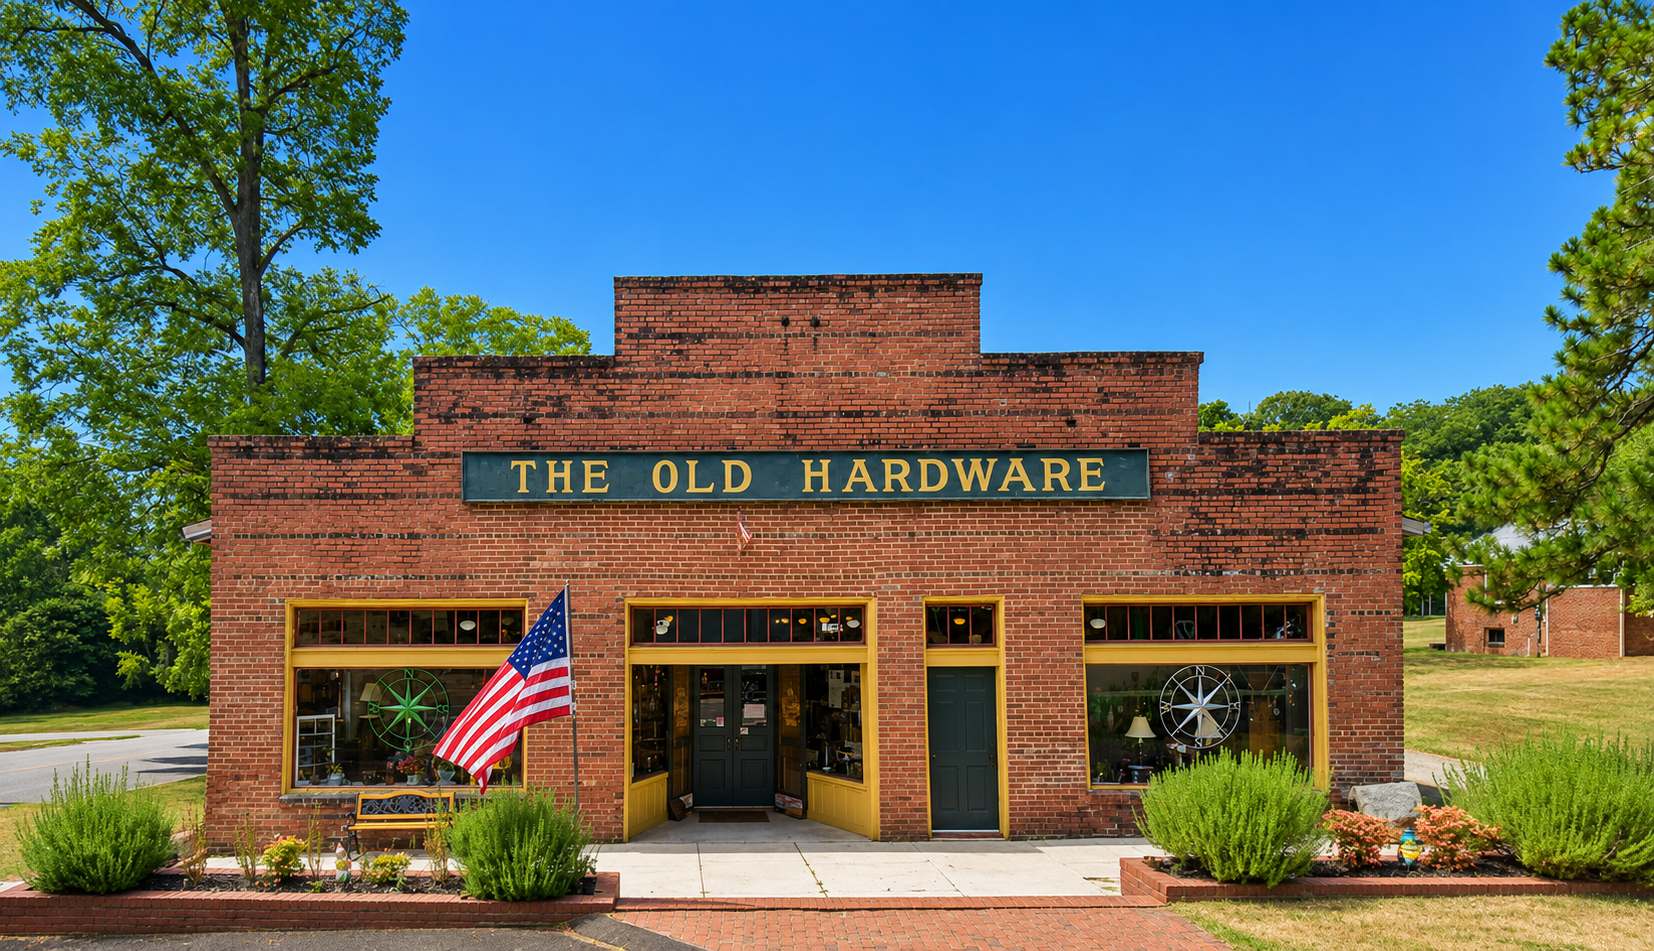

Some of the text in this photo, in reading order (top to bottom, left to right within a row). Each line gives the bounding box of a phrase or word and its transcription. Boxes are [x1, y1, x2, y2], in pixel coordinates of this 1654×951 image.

[510, 458, 1106, 494] THE OLD HARDWARE
[403, 668, 415, 680] N
[1195, 665, 1206, 677] N
